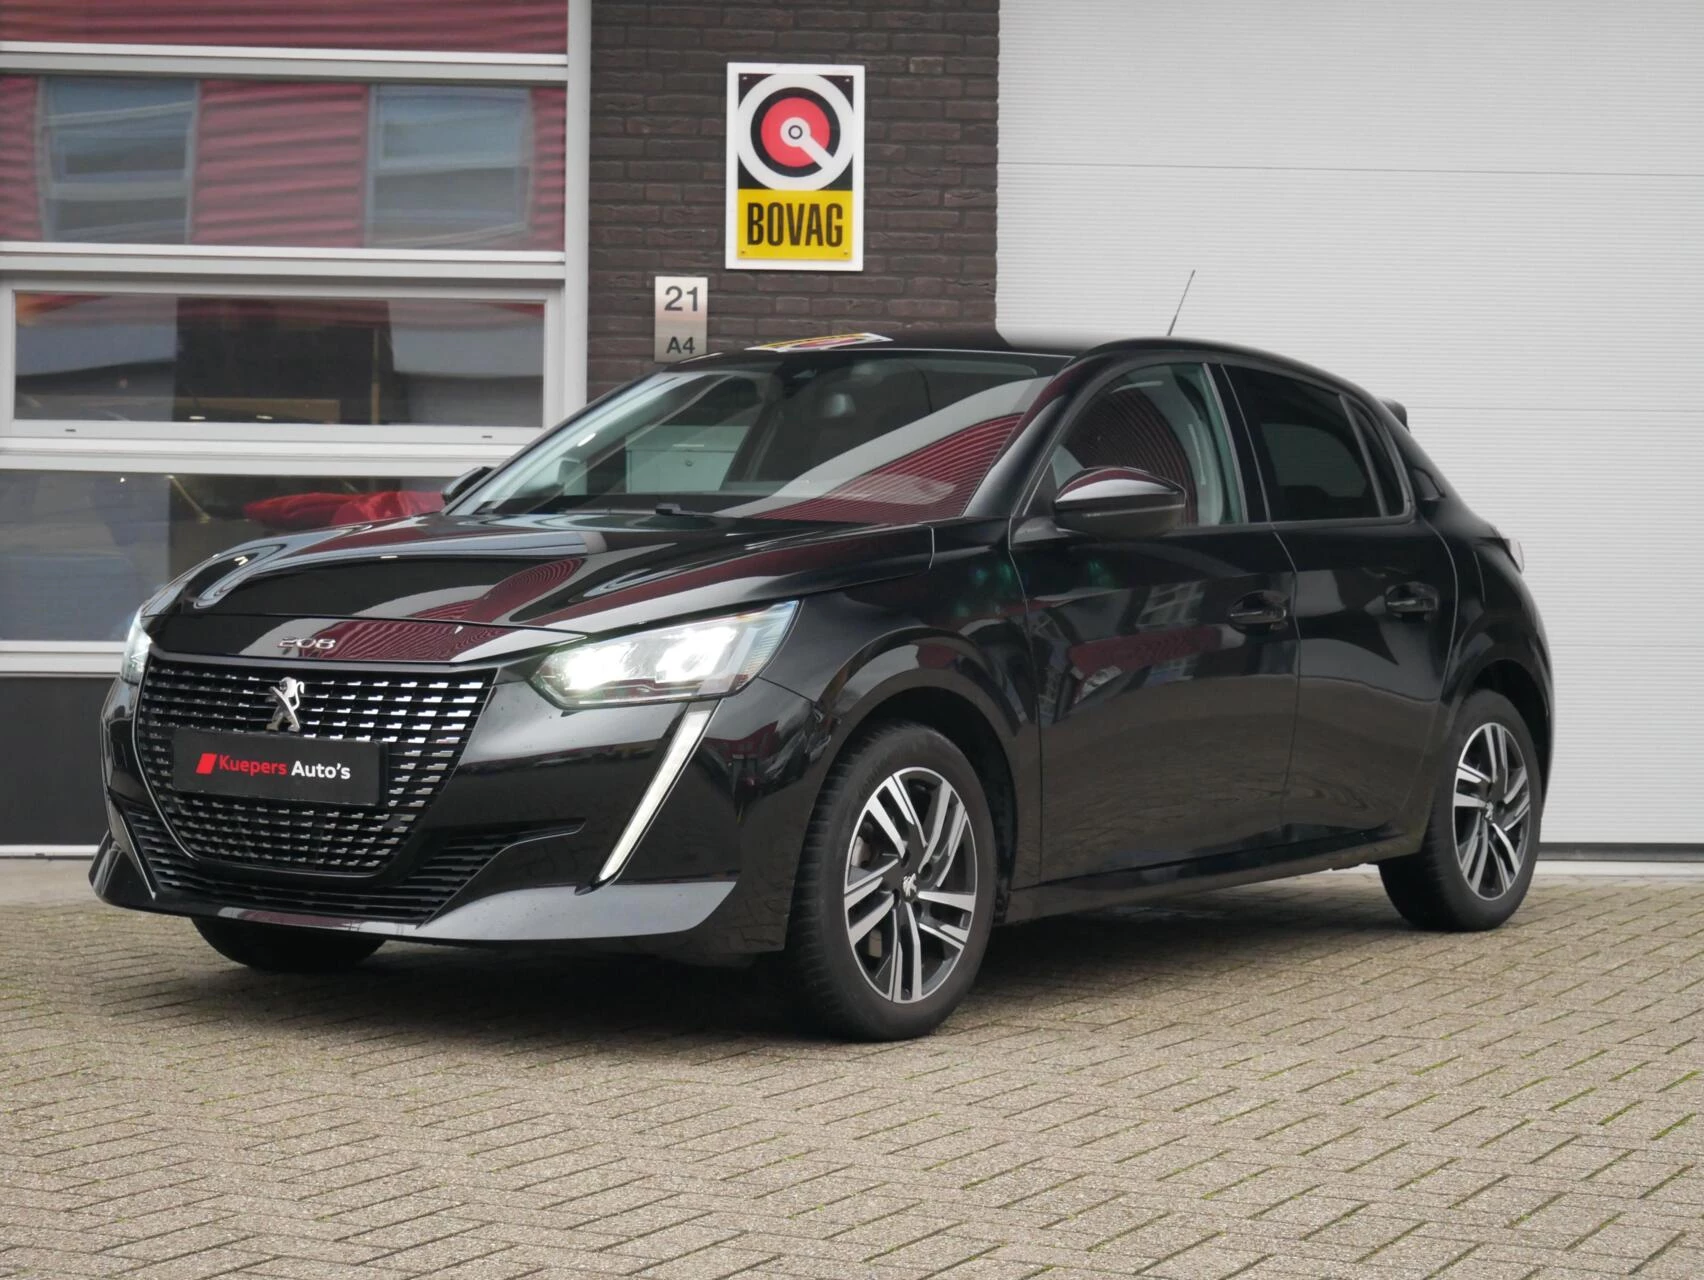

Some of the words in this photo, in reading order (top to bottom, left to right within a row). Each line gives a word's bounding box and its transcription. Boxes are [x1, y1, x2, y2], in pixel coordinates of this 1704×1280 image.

[747, 202, 843, 247] BOVAG
[664, 285, 698, 312] 21
[666, 336, 695, 354] A4
[277, 637, 337, 650] 208
[219, 754, 287, 776] Kuepers
[291, 760, 351, 780] Auto's
